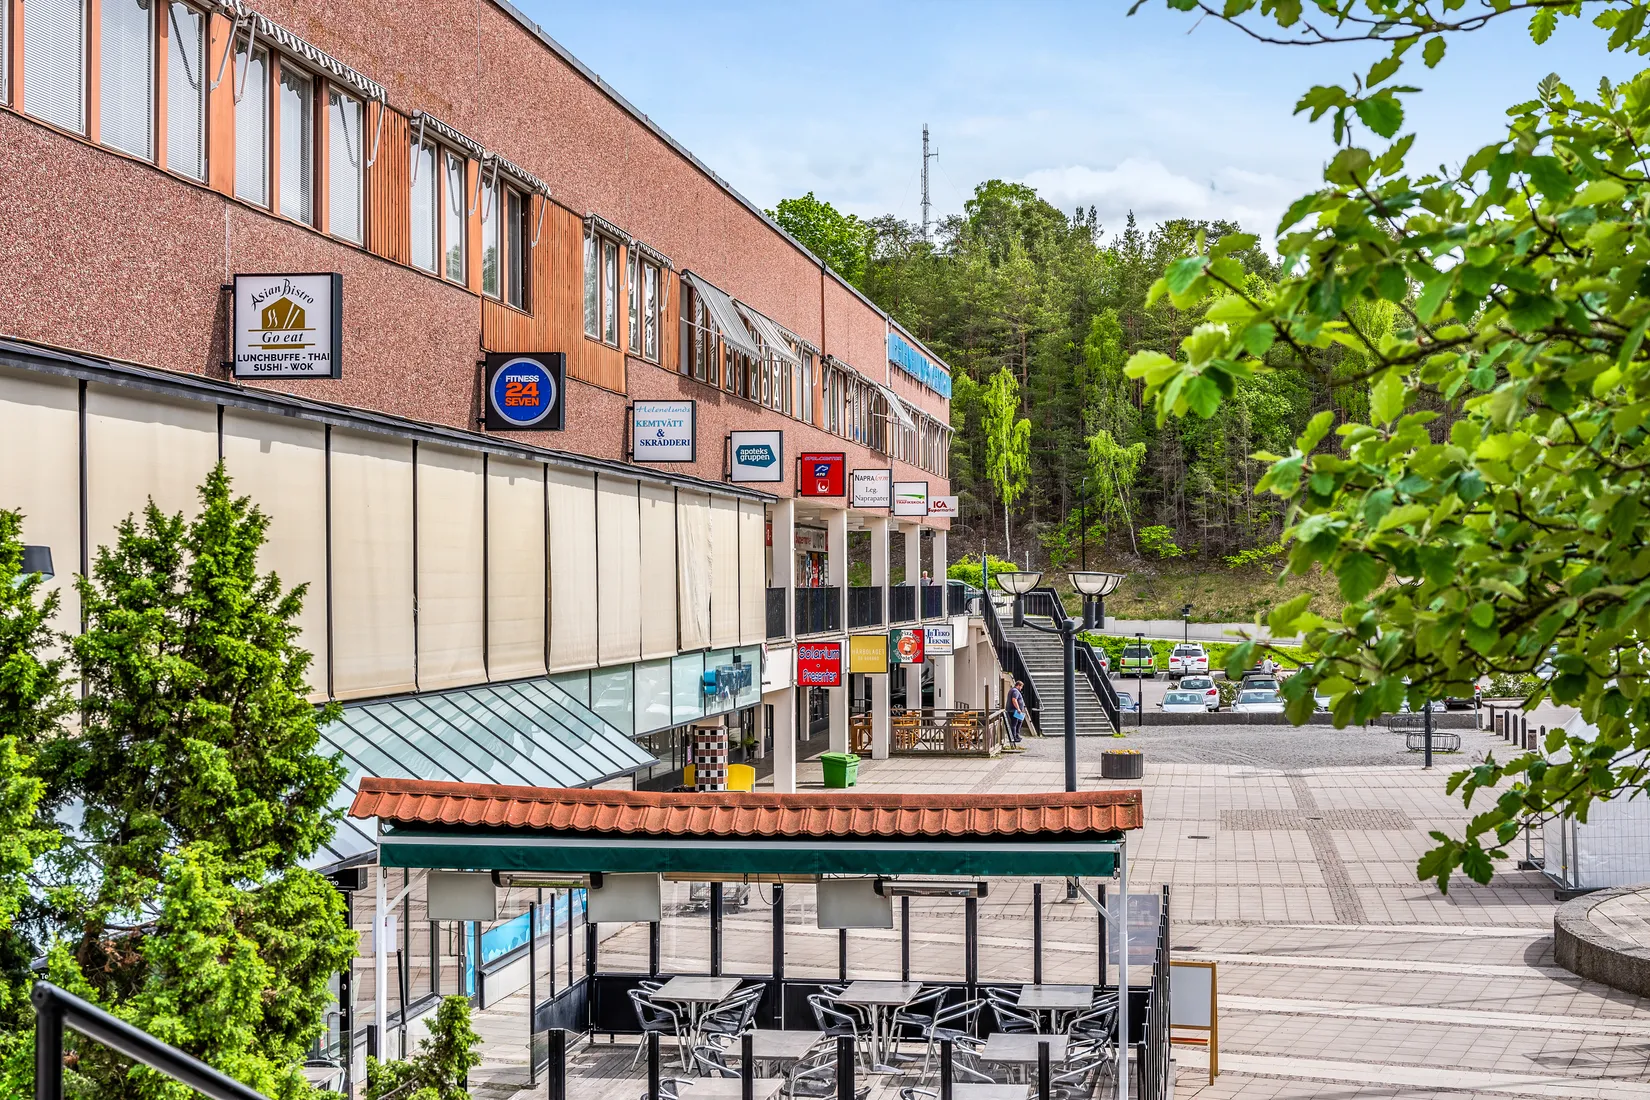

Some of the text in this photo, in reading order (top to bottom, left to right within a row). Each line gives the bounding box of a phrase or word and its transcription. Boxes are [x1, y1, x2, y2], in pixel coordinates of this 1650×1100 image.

[250, 278, 314, 311] Asian Bistro
[262, 331, 304, 343] Go eat
[237, 353, 300, 362] LUNCHBUFFE
[308, 353, 330, 361] THAI
[290, 363, 314, 371] WOK
[505, 375, 540, 383] FITNESS
[505, 382, 540, 397] 24
[505, 397, 540, 407] SEVEN
[635, 418, 684, 428] KEMTVÄTT
[656, 428, 665, 438] &
[639, 437, 691, 447] SKRÄDDERI
[740, 448, 768, 456] apoteks
[740, 454, 770, 462] gruppen
[865, 486, 878, 494] Leg.
[933, 500, 948, 509] ICA
[799, 646, 840, 660] Solarium
